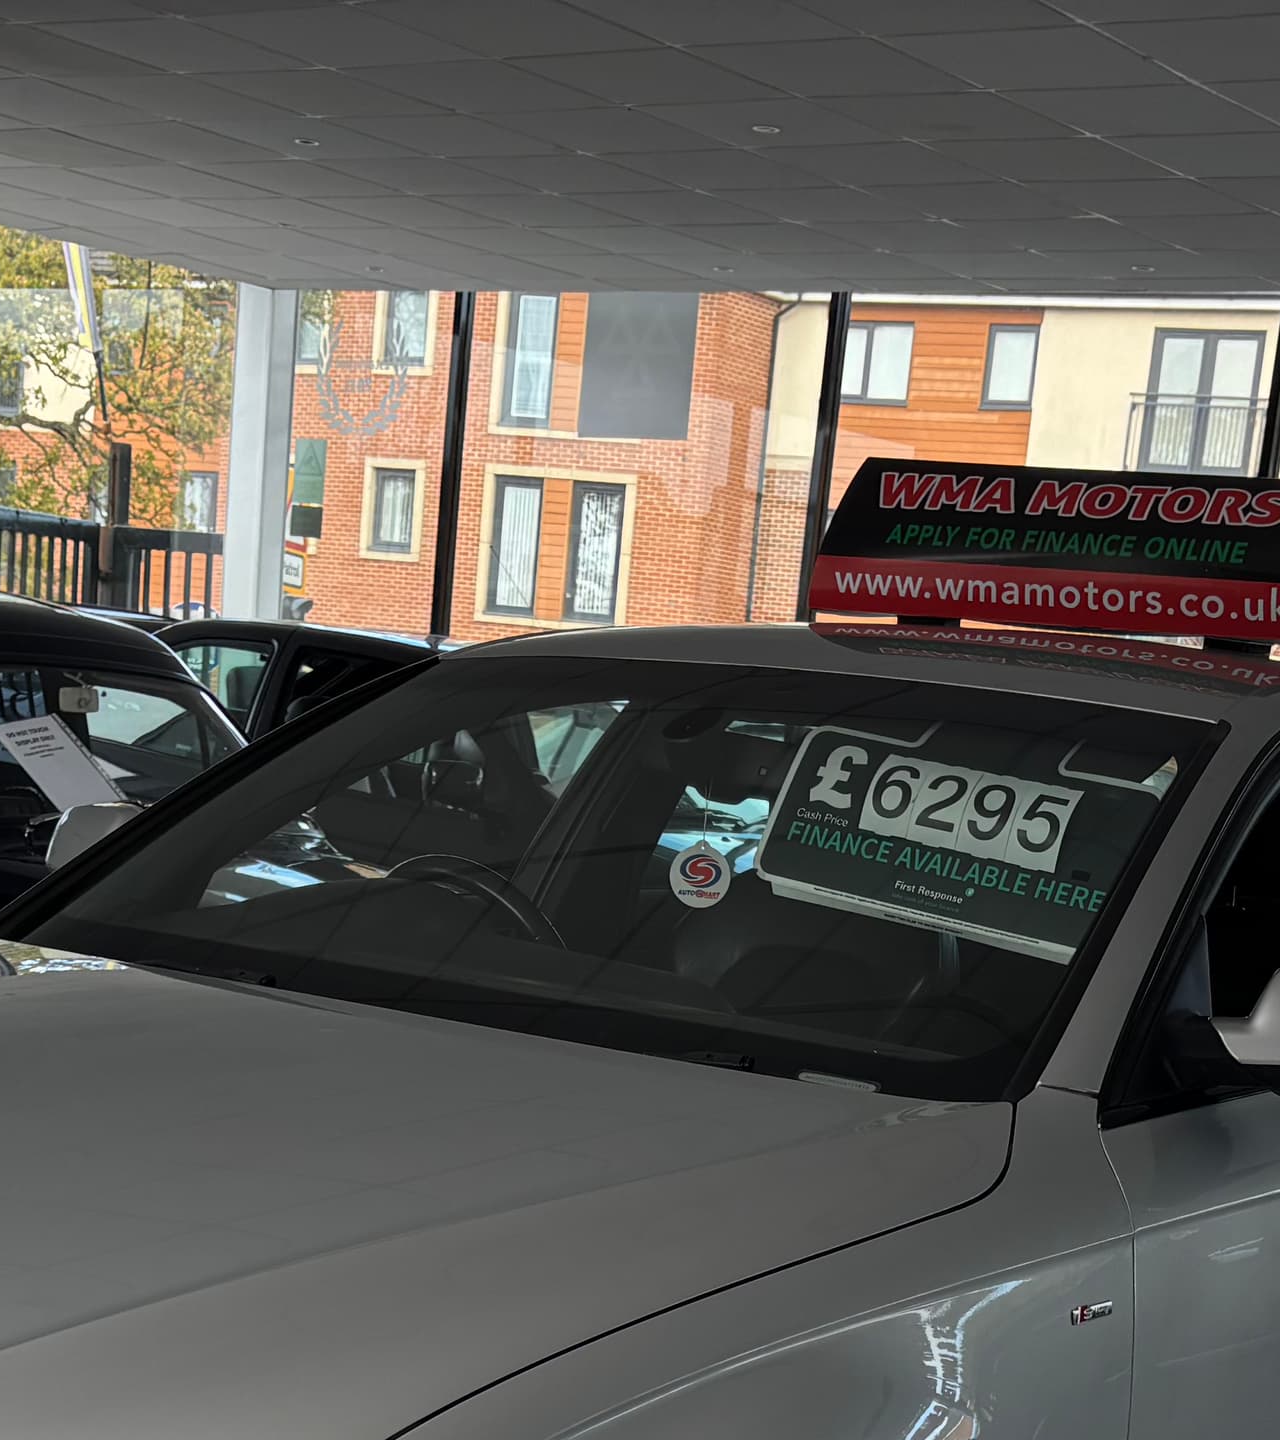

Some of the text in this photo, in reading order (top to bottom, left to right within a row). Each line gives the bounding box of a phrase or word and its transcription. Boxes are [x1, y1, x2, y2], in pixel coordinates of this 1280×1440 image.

[879, 470, 1016, 514] WMA
[886, 523, 1250, 564] APPLY FOR FINANCE ONLINE
[796, 807, 849, 828] Cash Price
[787, 820, 1108, 914] FINANCE AVAILABLE HERE
[894, 879, 917, 894] First
[917, 884, 964, 905] Response
